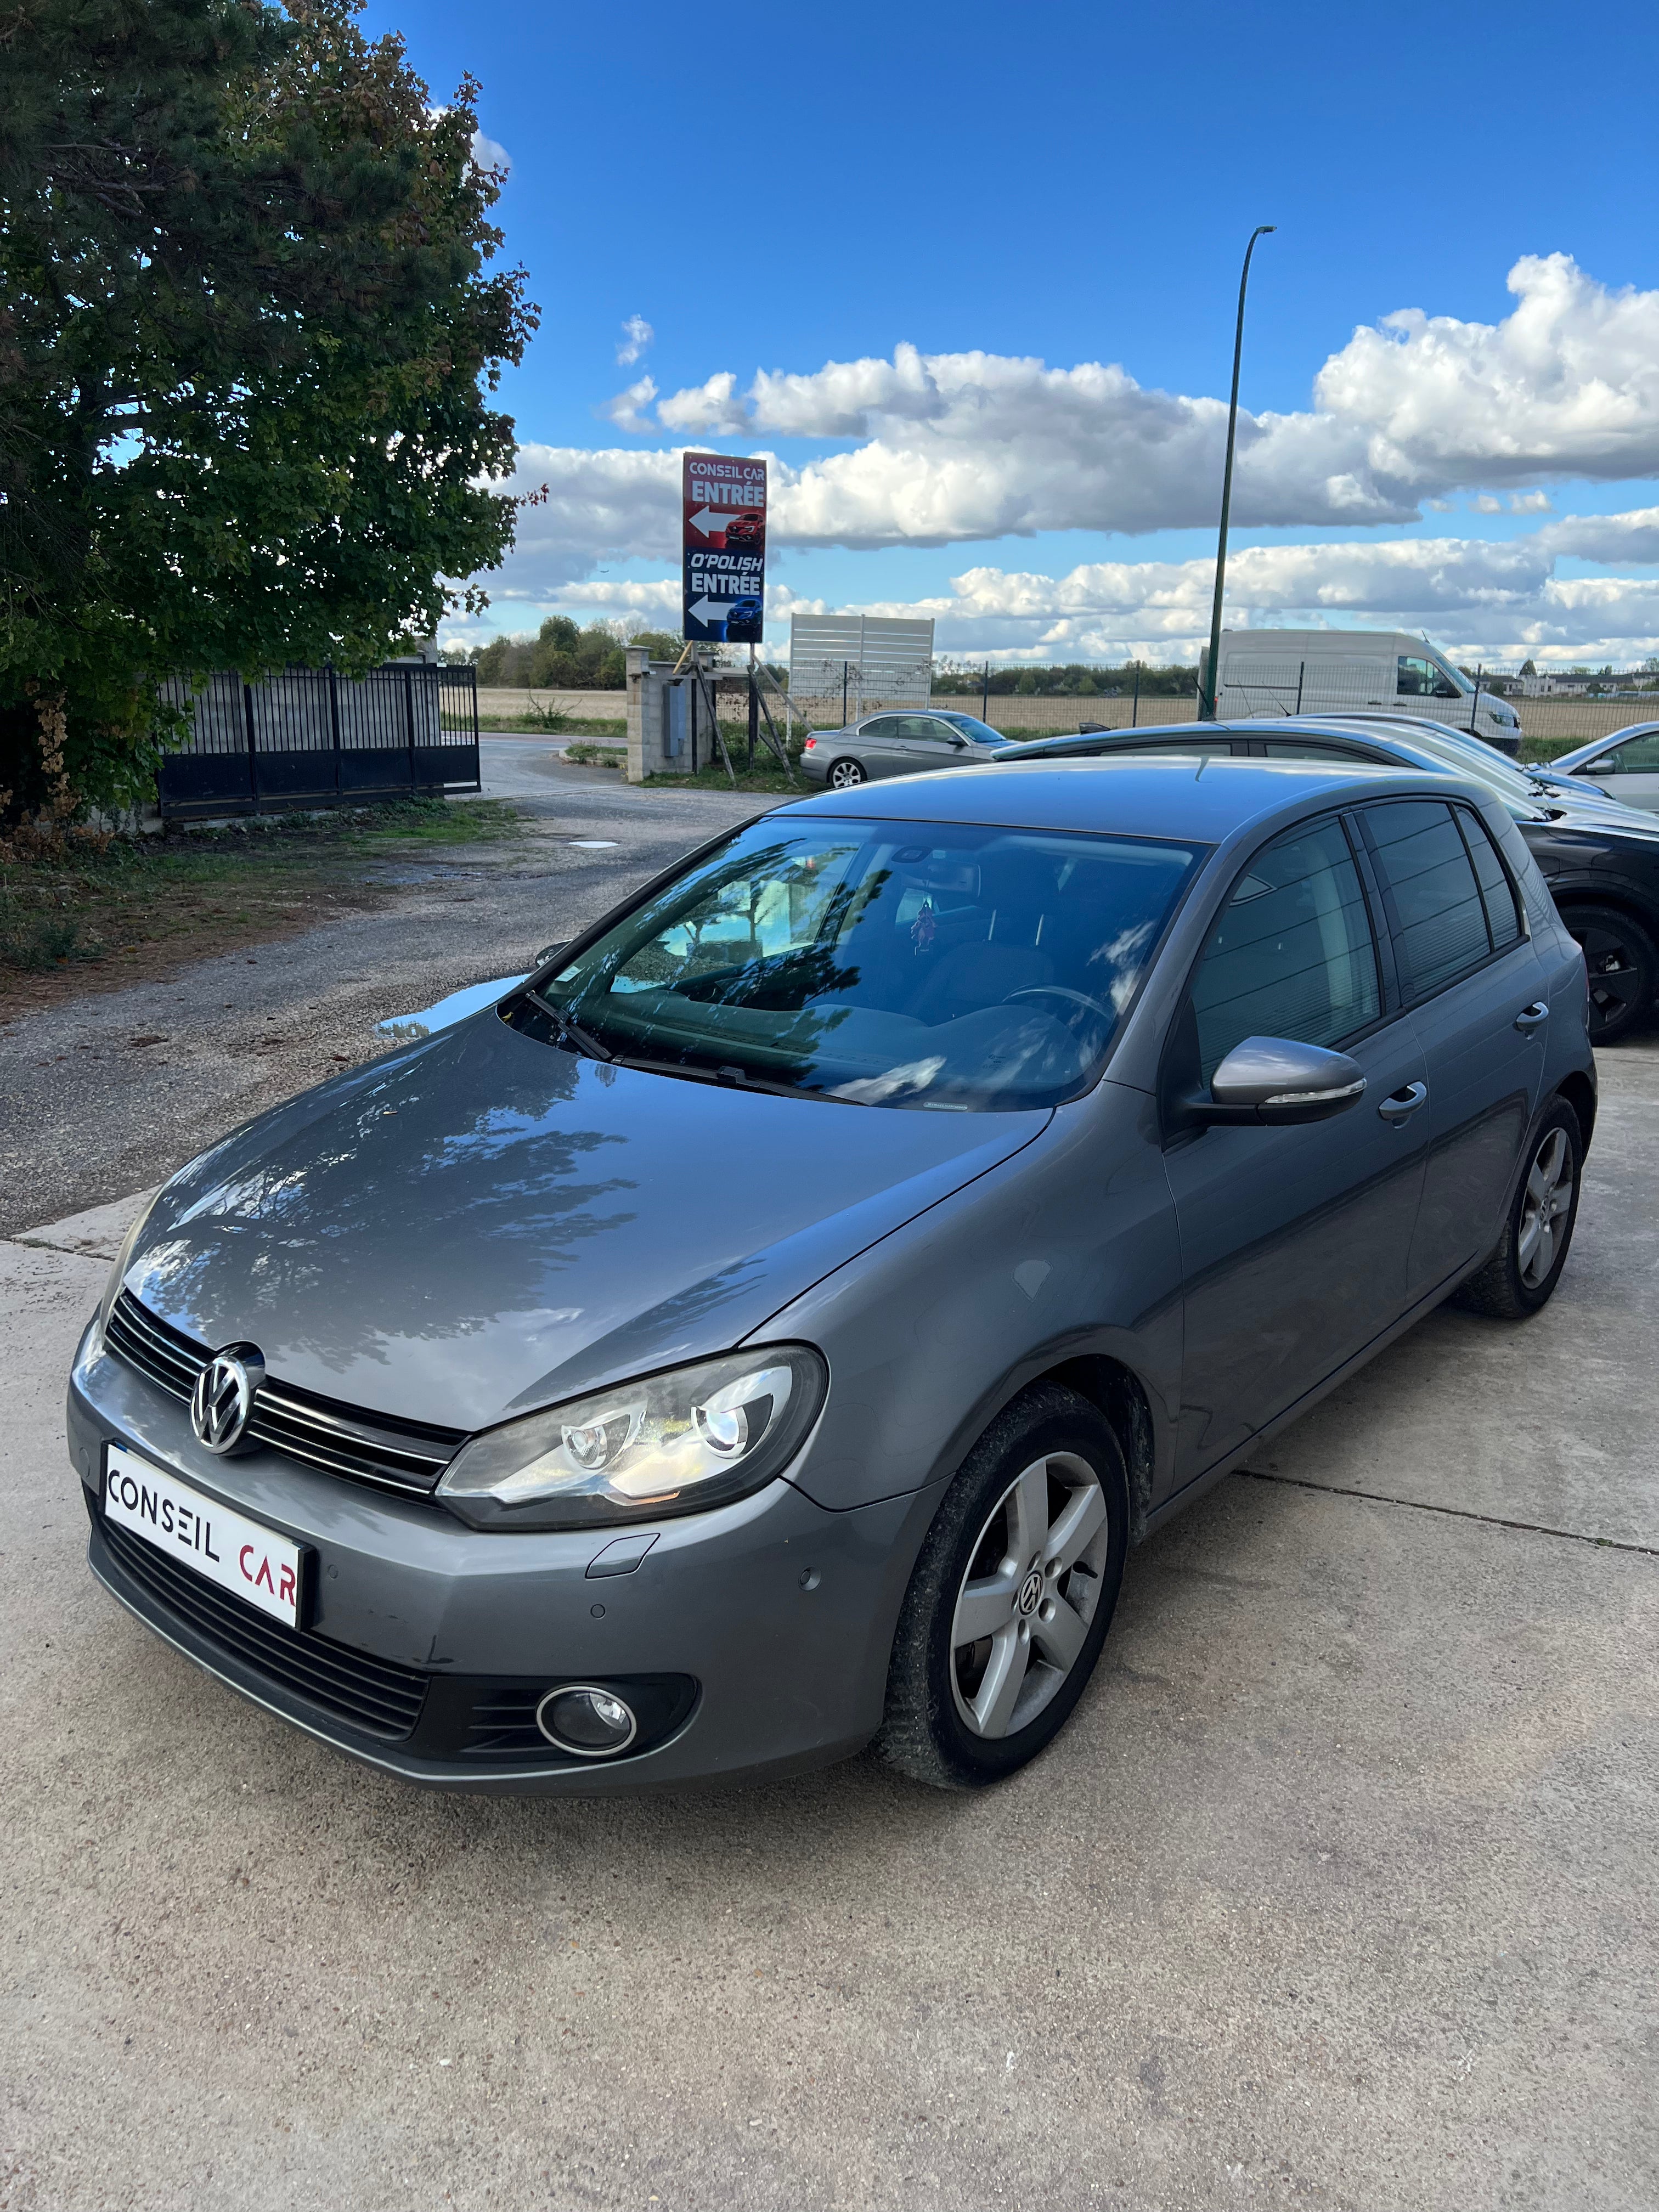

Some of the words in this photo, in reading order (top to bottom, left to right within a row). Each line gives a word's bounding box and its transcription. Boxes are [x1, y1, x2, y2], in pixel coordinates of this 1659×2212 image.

[689, 462, 743, 479] CONSEIL
[743, 467, 765, 481] CAR
[692, 480, 764, 507] ENTRÉE
[690, 553, 763, 572] O'POLISH
[691, 572, 760, 596] ENTRÉE
[108, 1469, 220, 1563] CONSEIL
[239, 1544, 296, 1607] CAR
